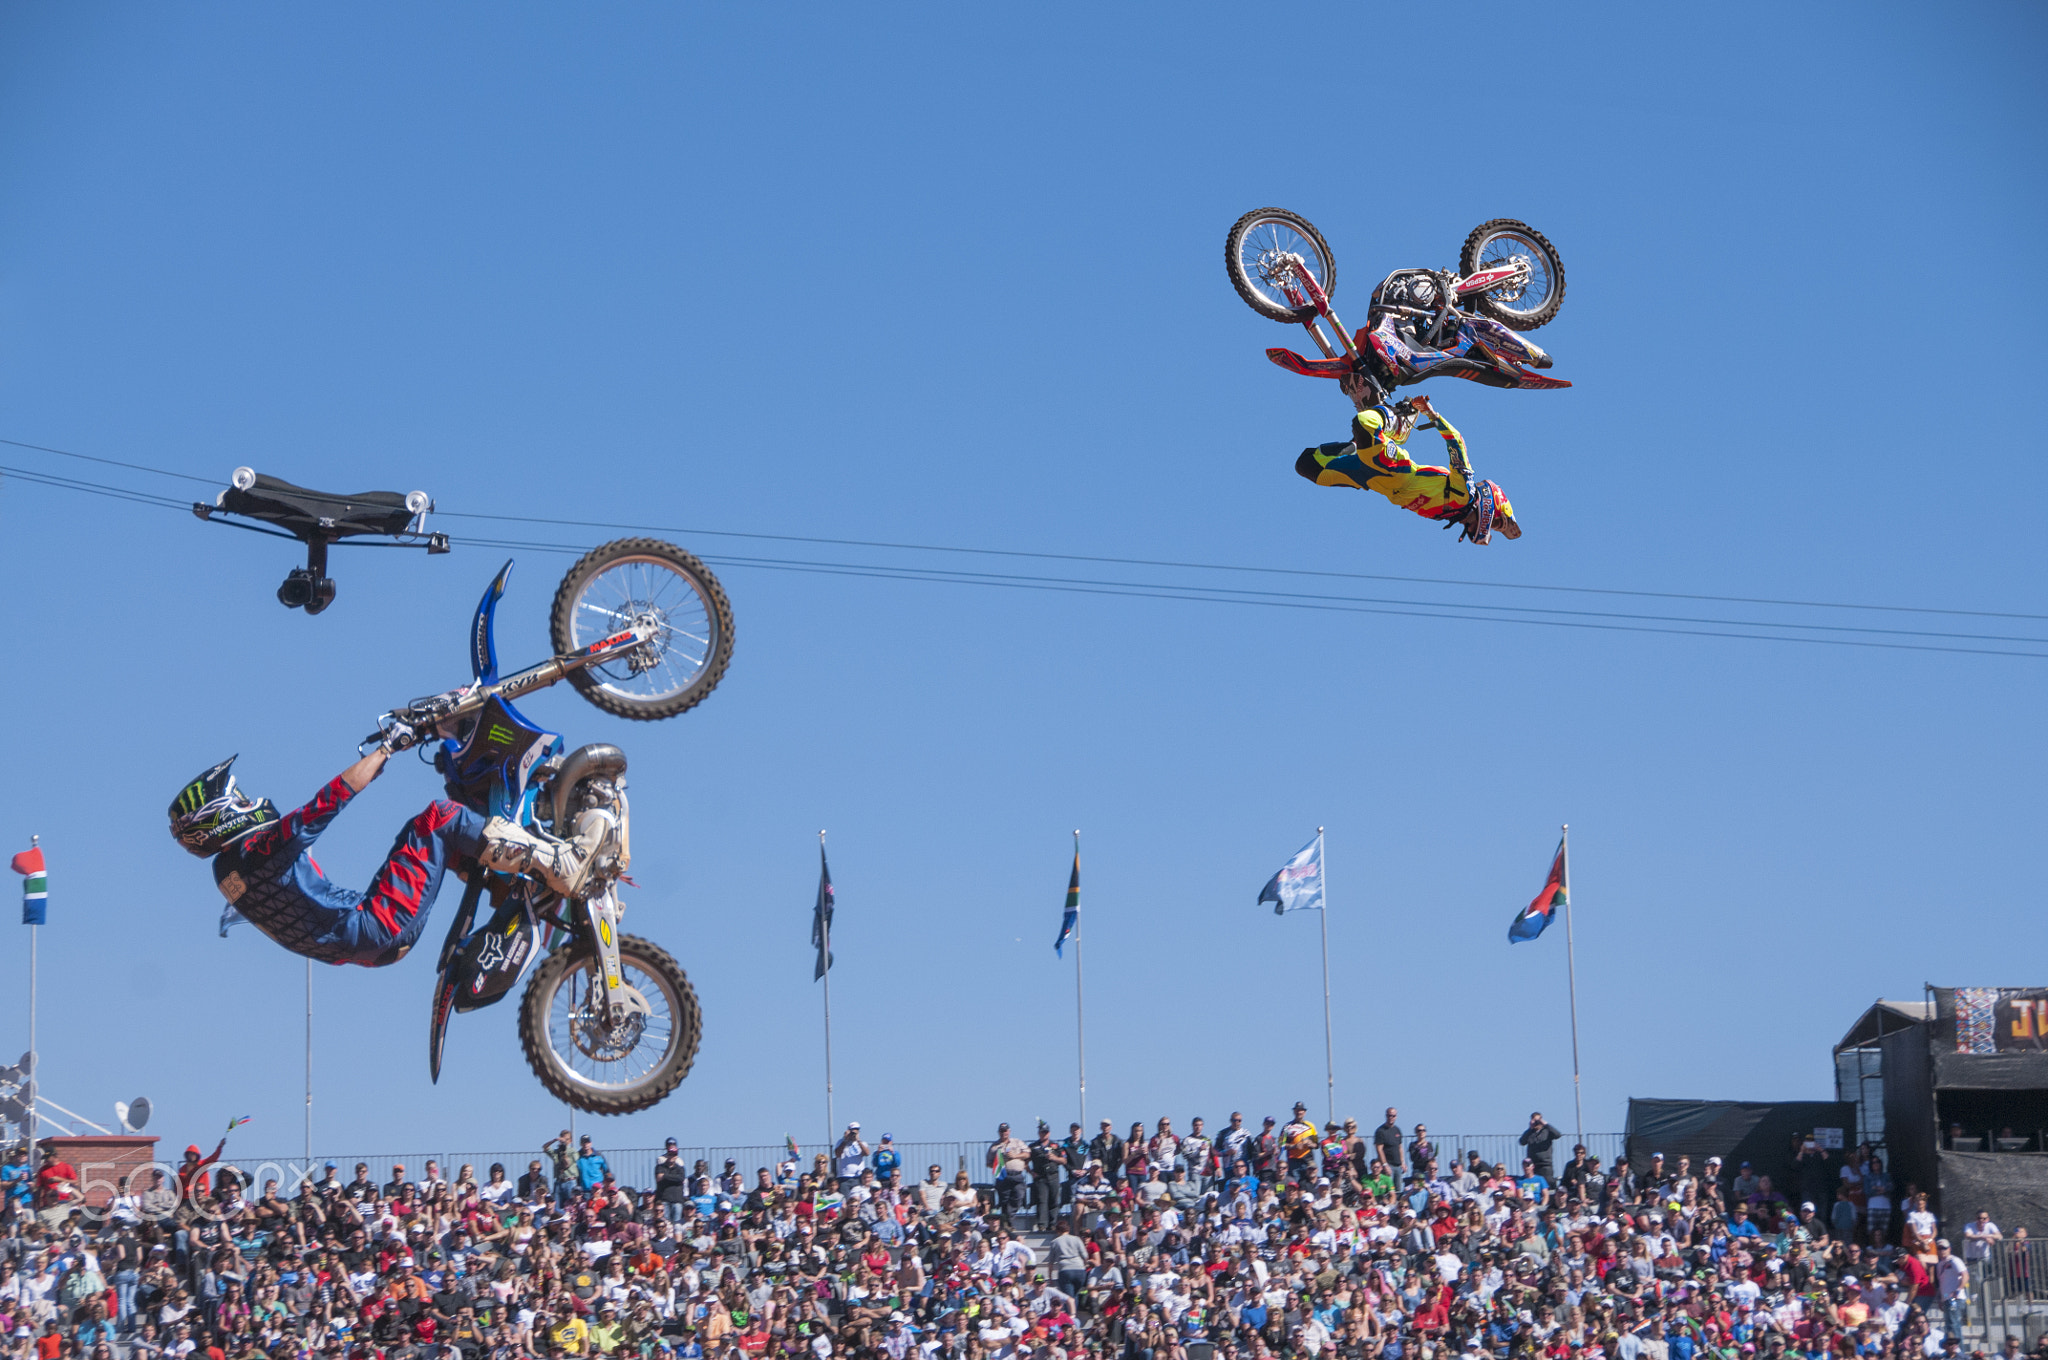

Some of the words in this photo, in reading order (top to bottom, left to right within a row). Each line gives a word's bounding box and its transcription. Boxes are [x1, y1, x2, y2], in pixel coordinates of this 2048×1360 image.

[1293, 265, 1315, 292] CEPSA
[1466, 276, 1486, 287] CEPSA
[589, 631, 633, 653] MAXXIS
[501, 673, 540, 694] KYB
[208, 815, 249, 836] MONSTER
[438, 984, 454, 1025] MAXXIS
